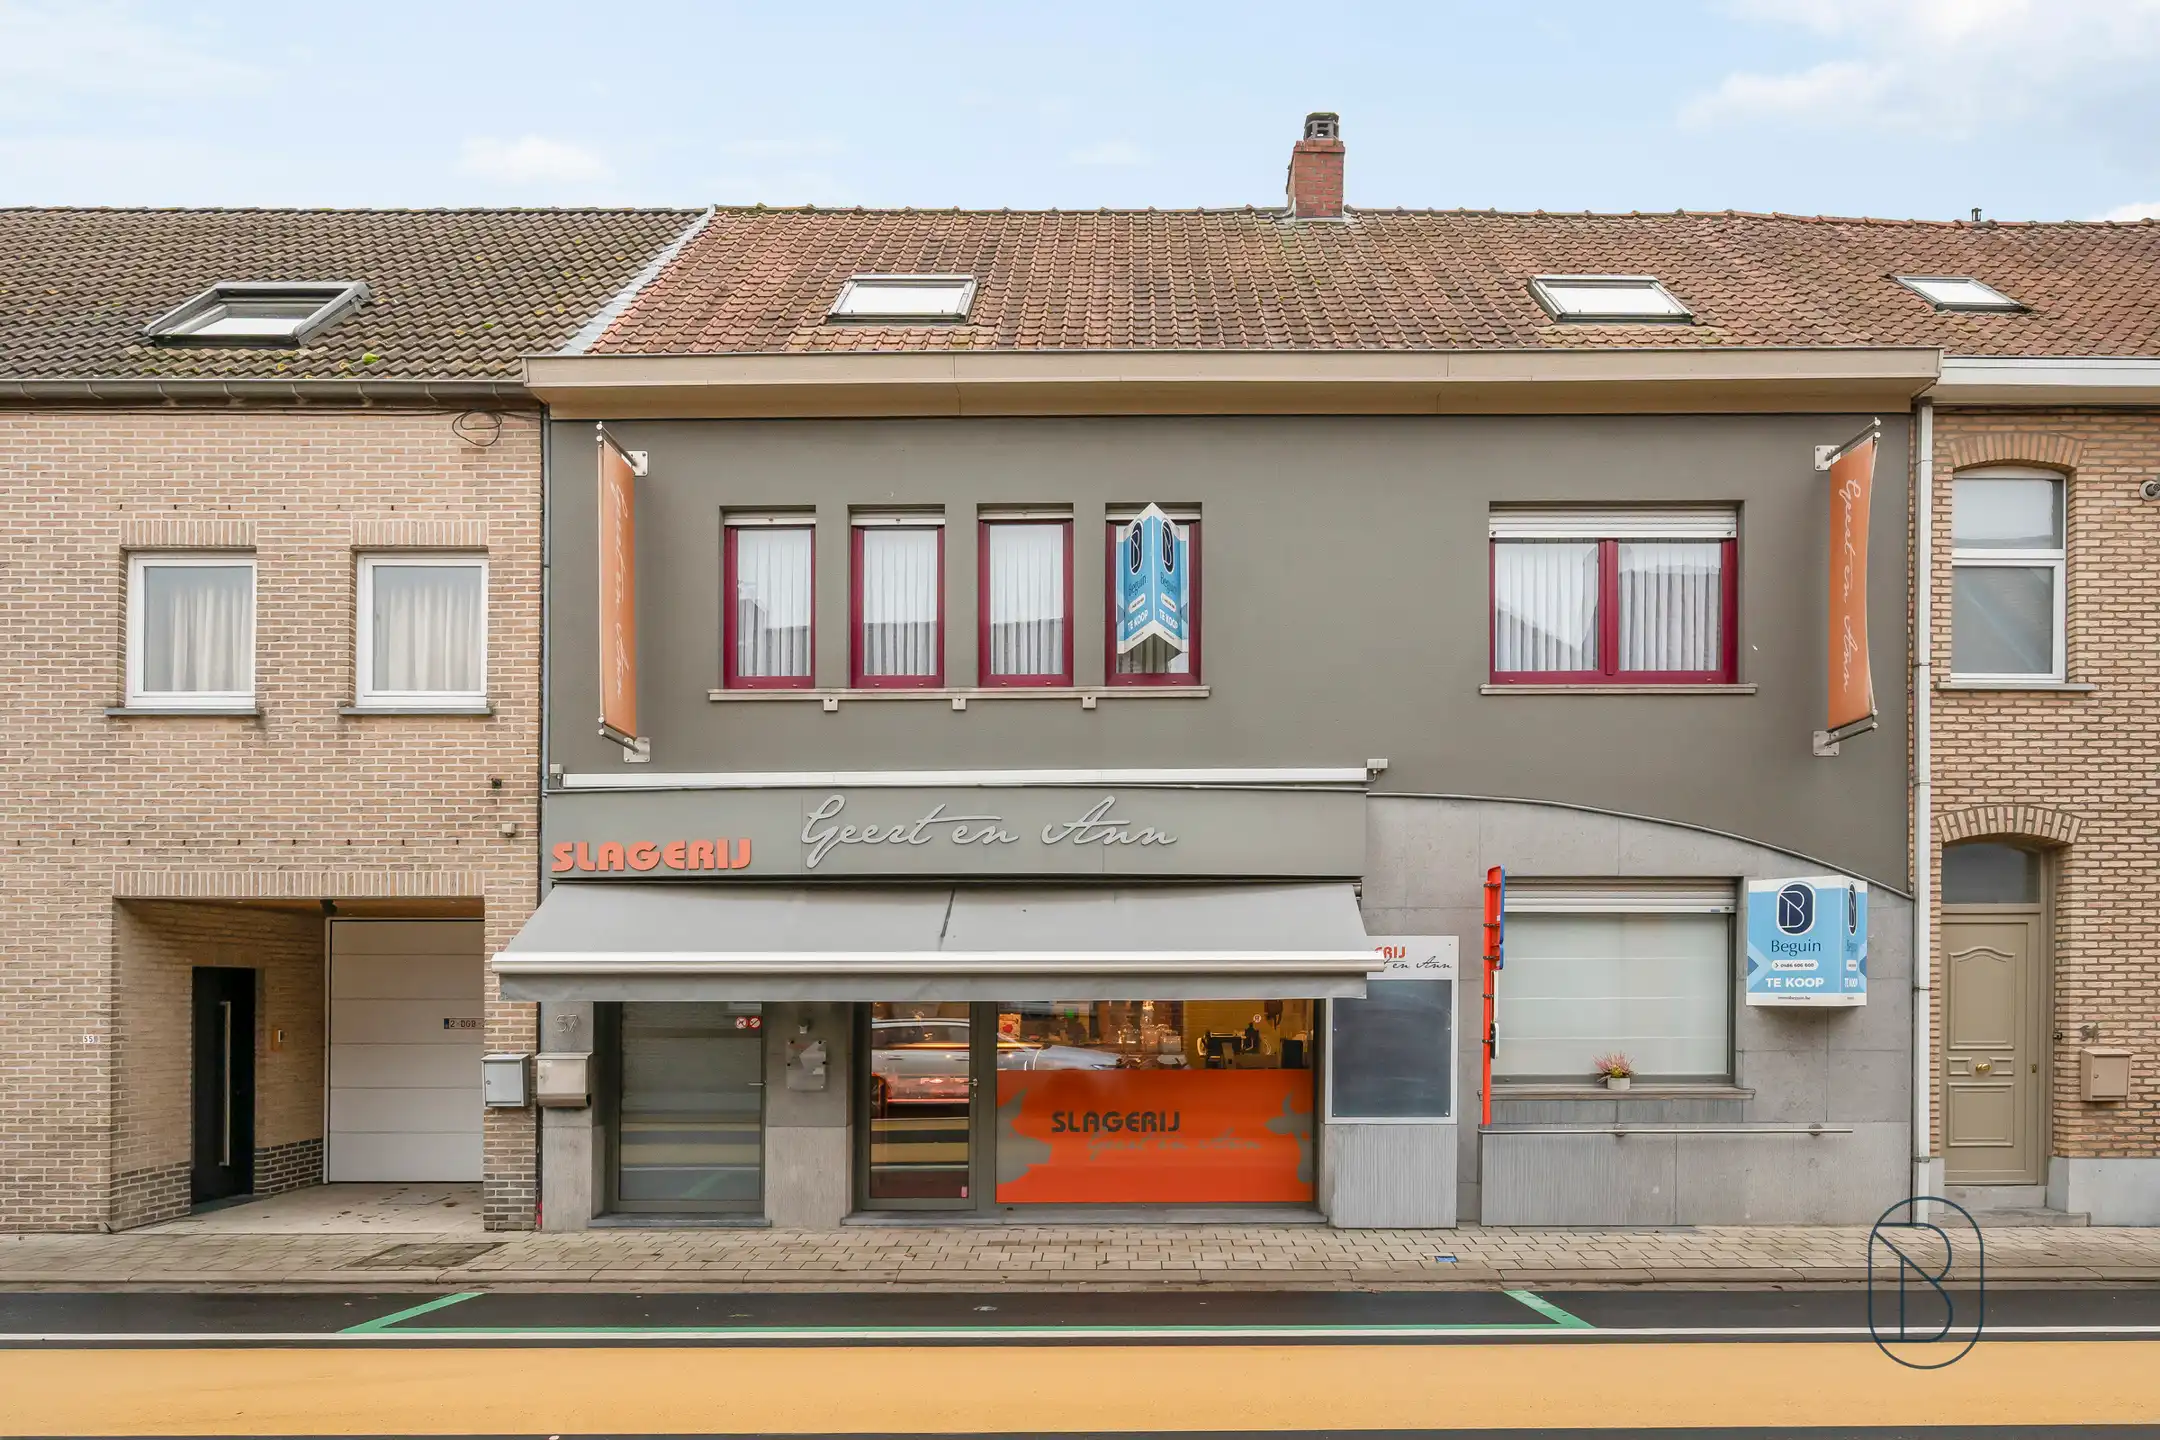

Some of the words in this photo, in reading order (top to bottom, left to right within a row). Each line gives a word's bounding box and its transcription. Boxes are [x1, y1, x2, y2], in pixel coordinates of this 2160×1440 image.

[801, 794, 1001, 869] Geert
[951, 823, 1020, 845] en
[1041, 795, 1178, 846] Ann
[551, 838, 752, 872] SLAGERIJ
[1771, 939, 1821, 956] Beguin
[1416, 956, 1452, 969] Ann
[1765, 977, 1781, 988] TE
[1786, 977, 1825, 988] KOOP
[556, 1014, 579, 1033] 57
[84, 1035, 93, 1043] 55
[1051, 1110, 1181, 1133] SLAGERIJ
